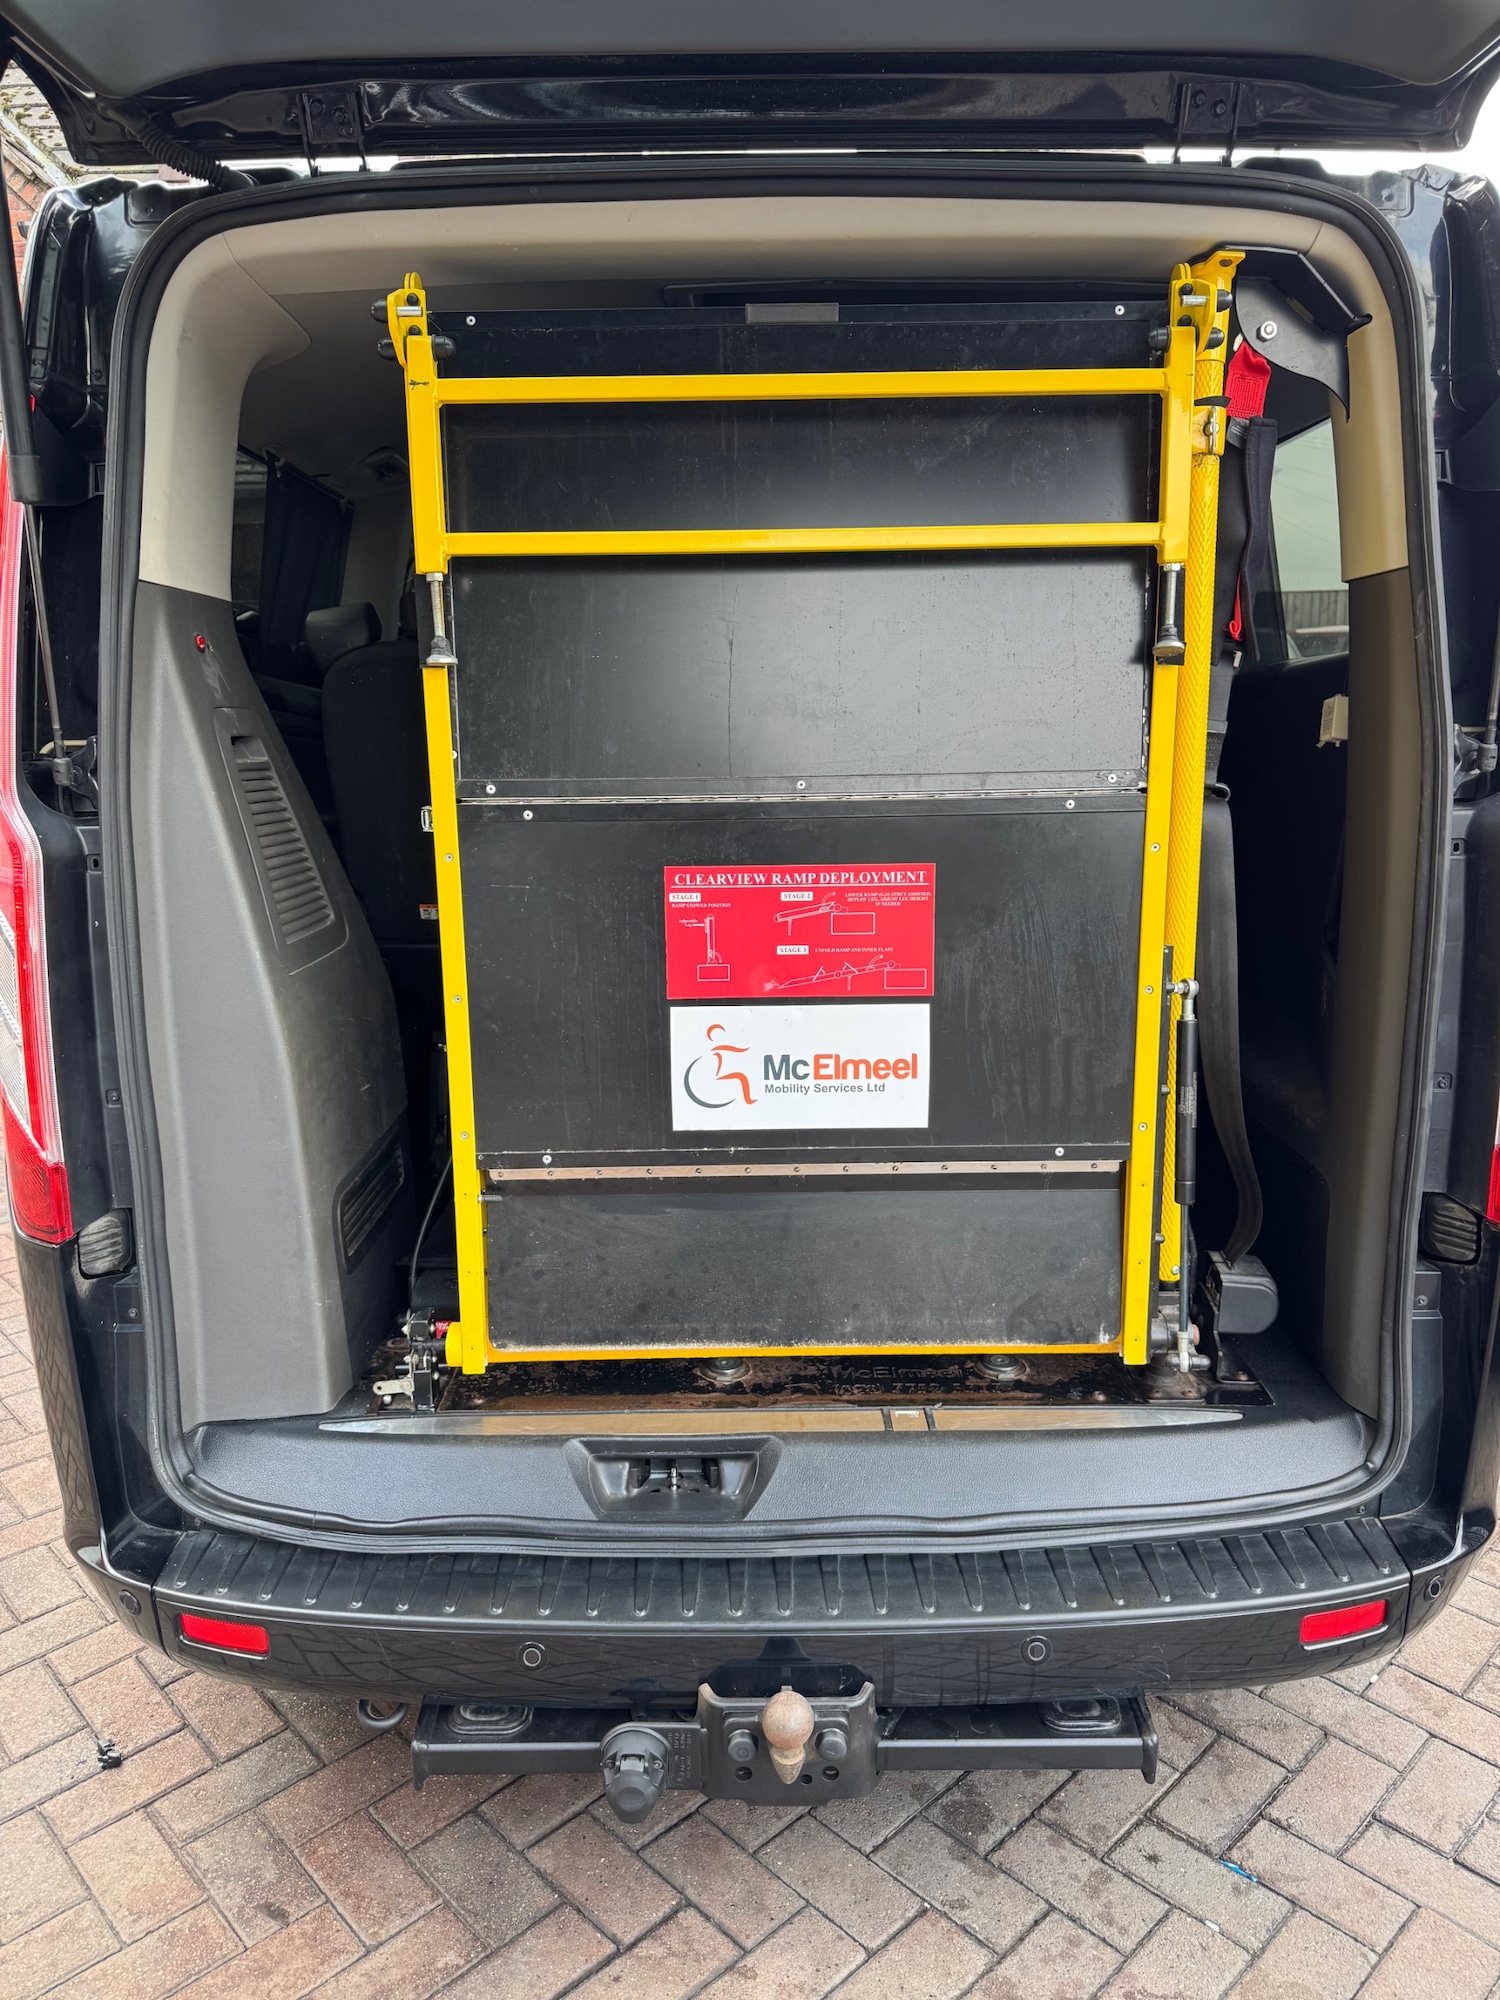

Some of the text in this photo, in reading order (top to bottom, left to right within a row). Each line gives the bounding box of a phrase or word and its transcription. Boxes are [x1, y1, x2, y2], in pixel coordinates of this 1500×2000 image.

[674, 870, 927, 886] CLEARVIEW RAMP DEPLOYMENT
[764, 1082, 886, 1095] Mobility Services Ltd
